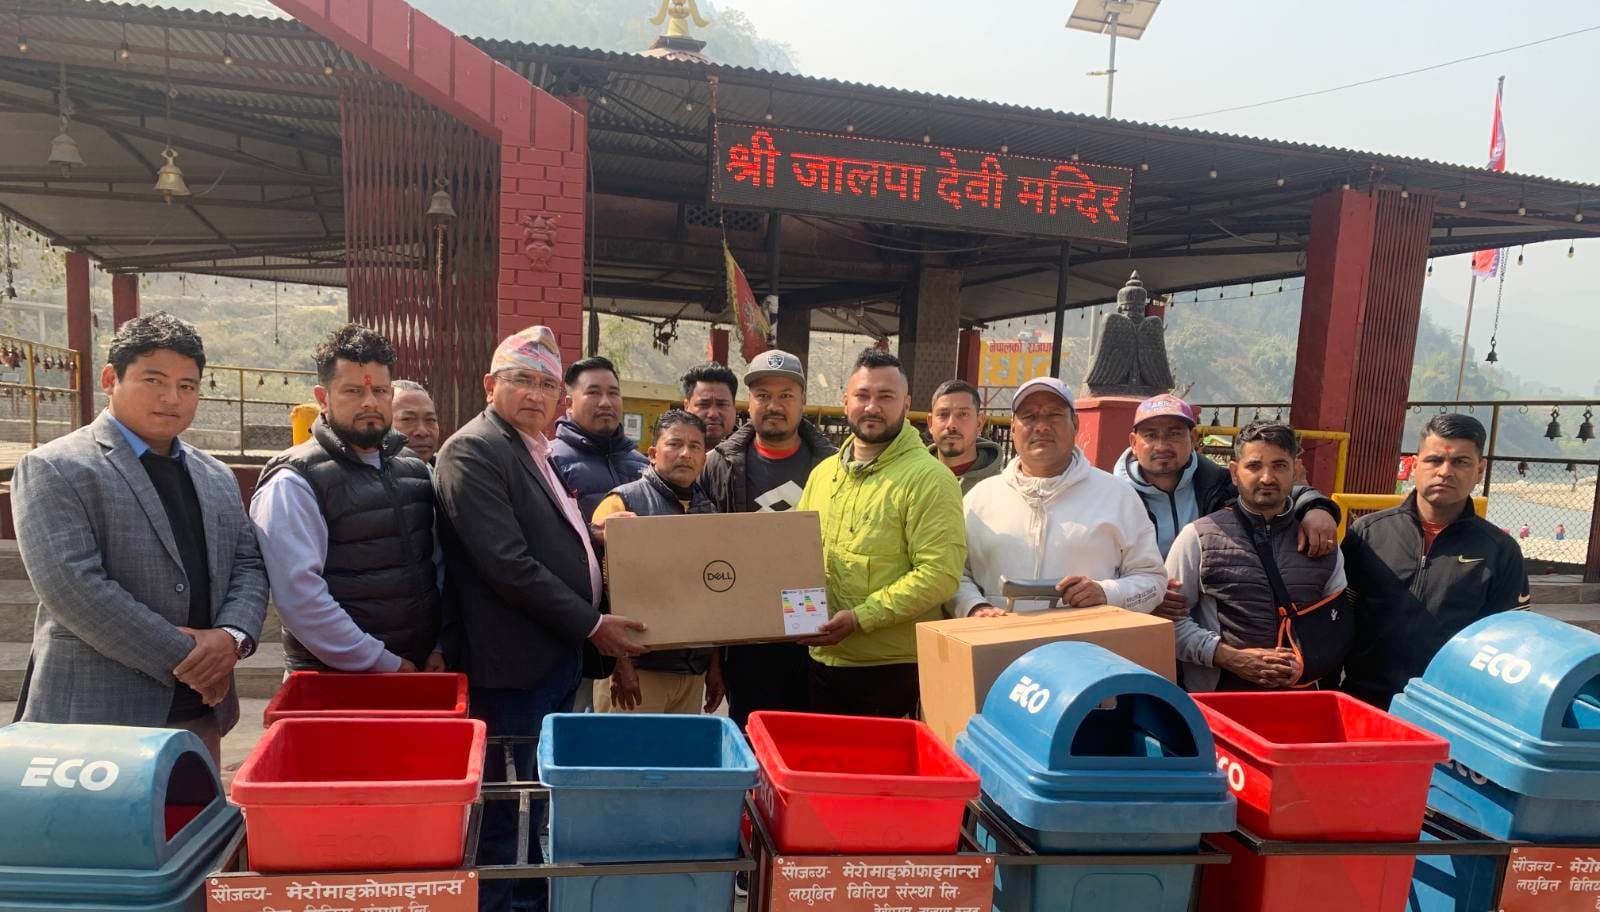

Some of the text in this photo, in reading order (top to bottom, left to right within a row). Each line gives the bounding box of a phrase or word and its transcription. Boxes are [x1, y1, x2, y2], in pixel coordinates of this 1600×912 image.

[726, 130, 1123, 224] श्री जालपा देवी मन्दिर
[707, 572, 733, 581] DELL
[1470, 644, 1531, 684] ECO
[1008, 675, 1050, 714] ECO
[21, 757, 119, 791] ECO
[896, 883, 935, 900] संस्था
